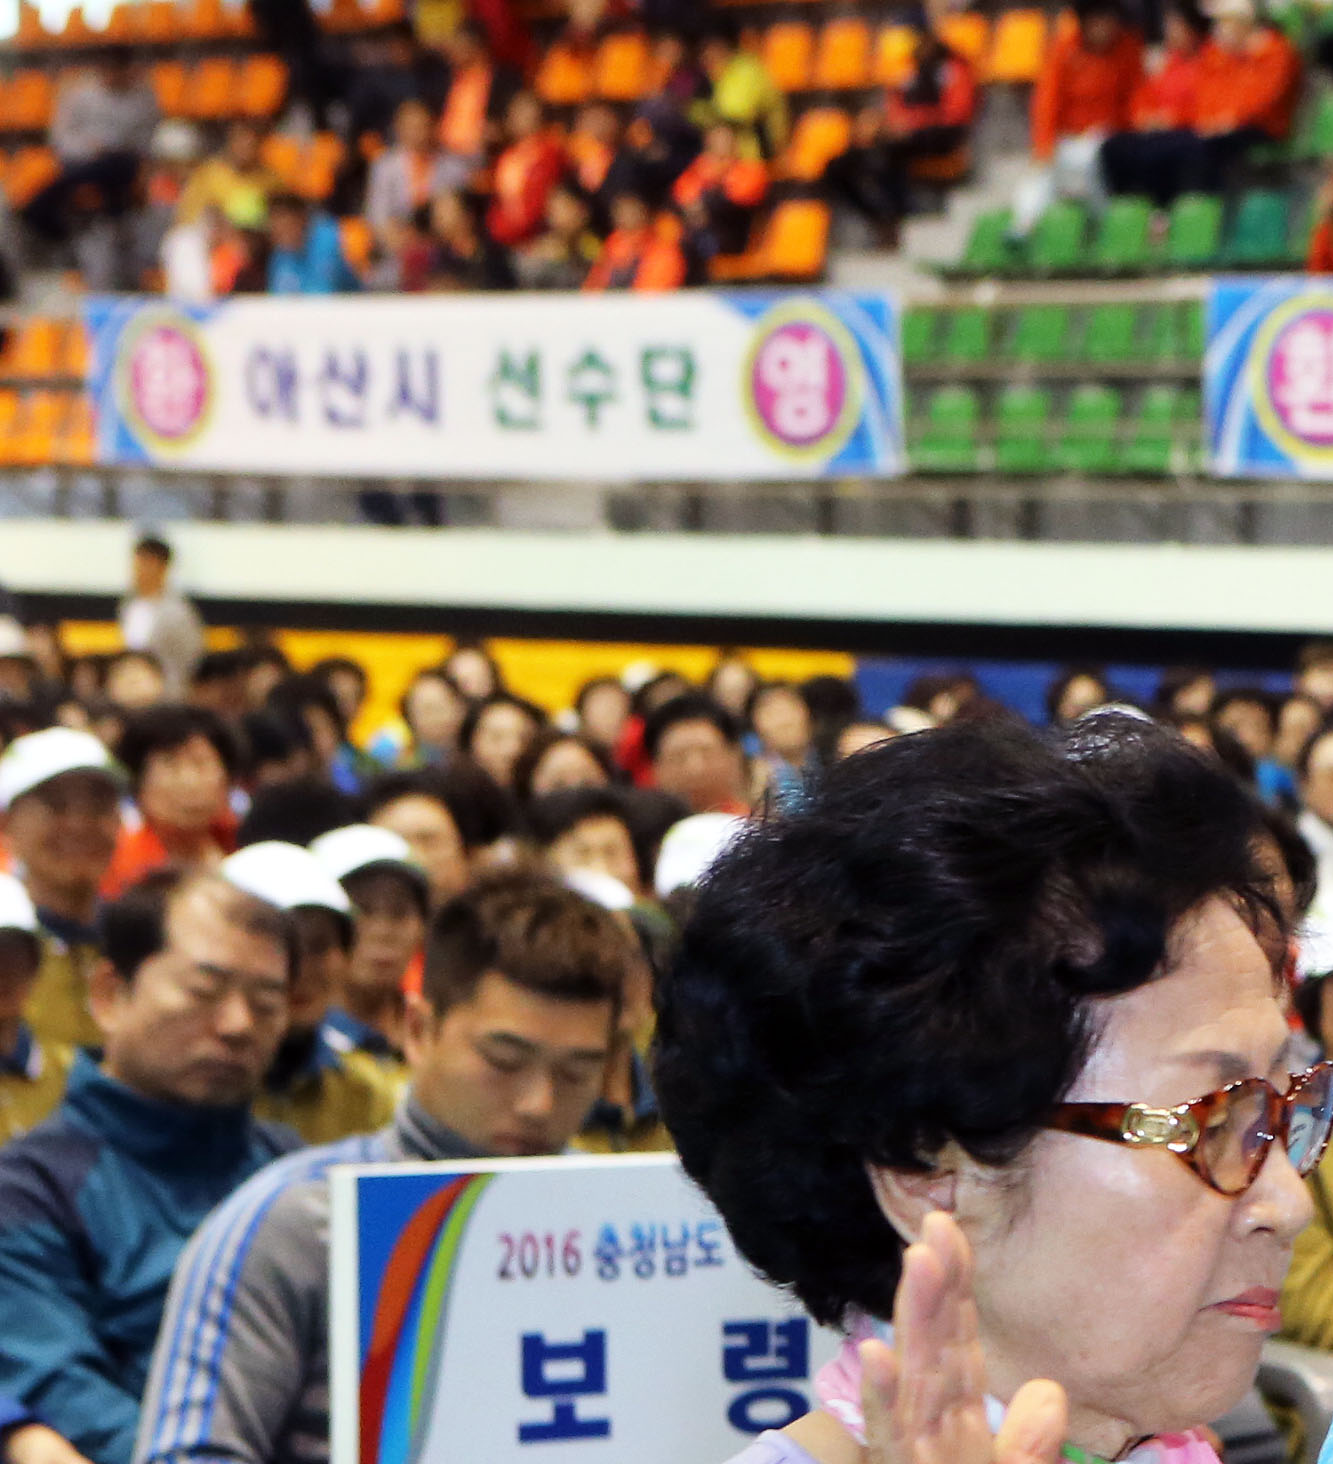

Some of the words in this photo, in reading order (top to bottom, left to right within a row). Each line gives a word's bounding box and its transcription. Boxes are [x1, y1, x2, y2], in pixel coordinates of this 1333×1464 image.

[246, 343, 443, 429] 아산시
[490, 343, 698, 434] 선수단
[497, 1230, 583, 1281] 2016
[594, 1218, 726, 1280] 충청남도
